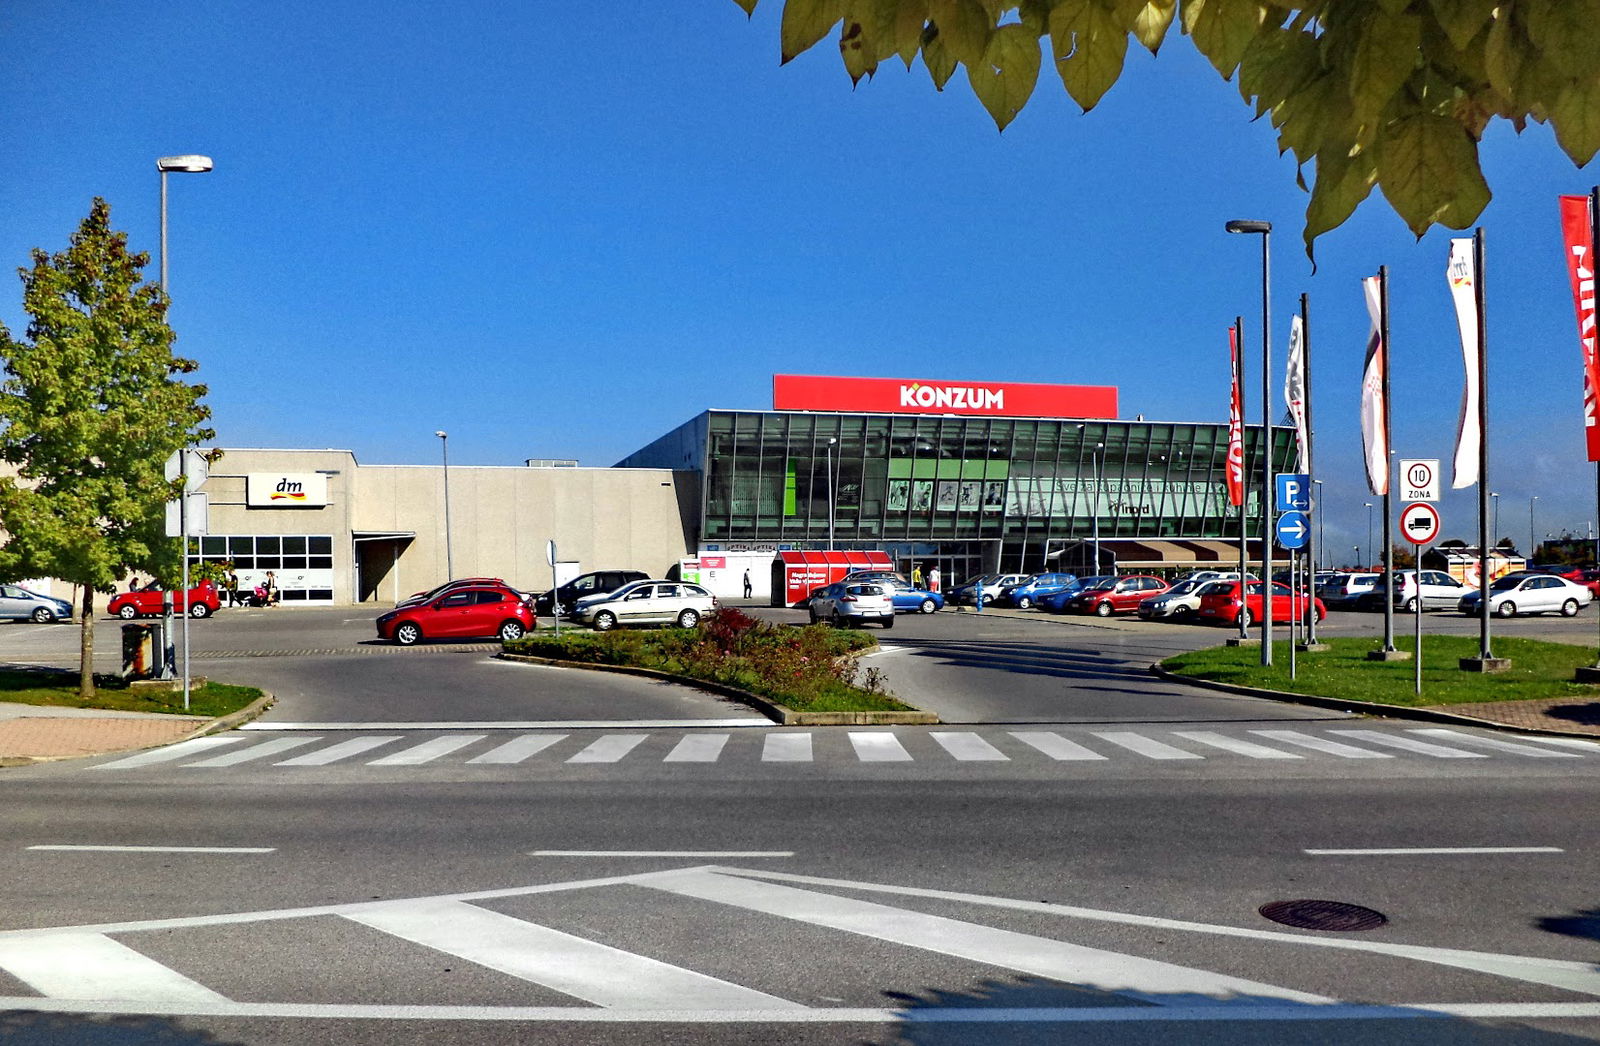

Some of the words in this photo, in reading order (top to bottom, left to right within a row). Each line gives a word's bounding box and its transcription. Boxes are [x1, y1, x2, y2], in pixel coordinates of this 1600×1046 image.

[900, 384, 1004, 409] KONZUM
[1415, 470, 1426, 482] 10
[276, 478, 302, 492] dm
[1285, 481, 1300, 504] P
[1408, 490, 1431, 498] ZONA
